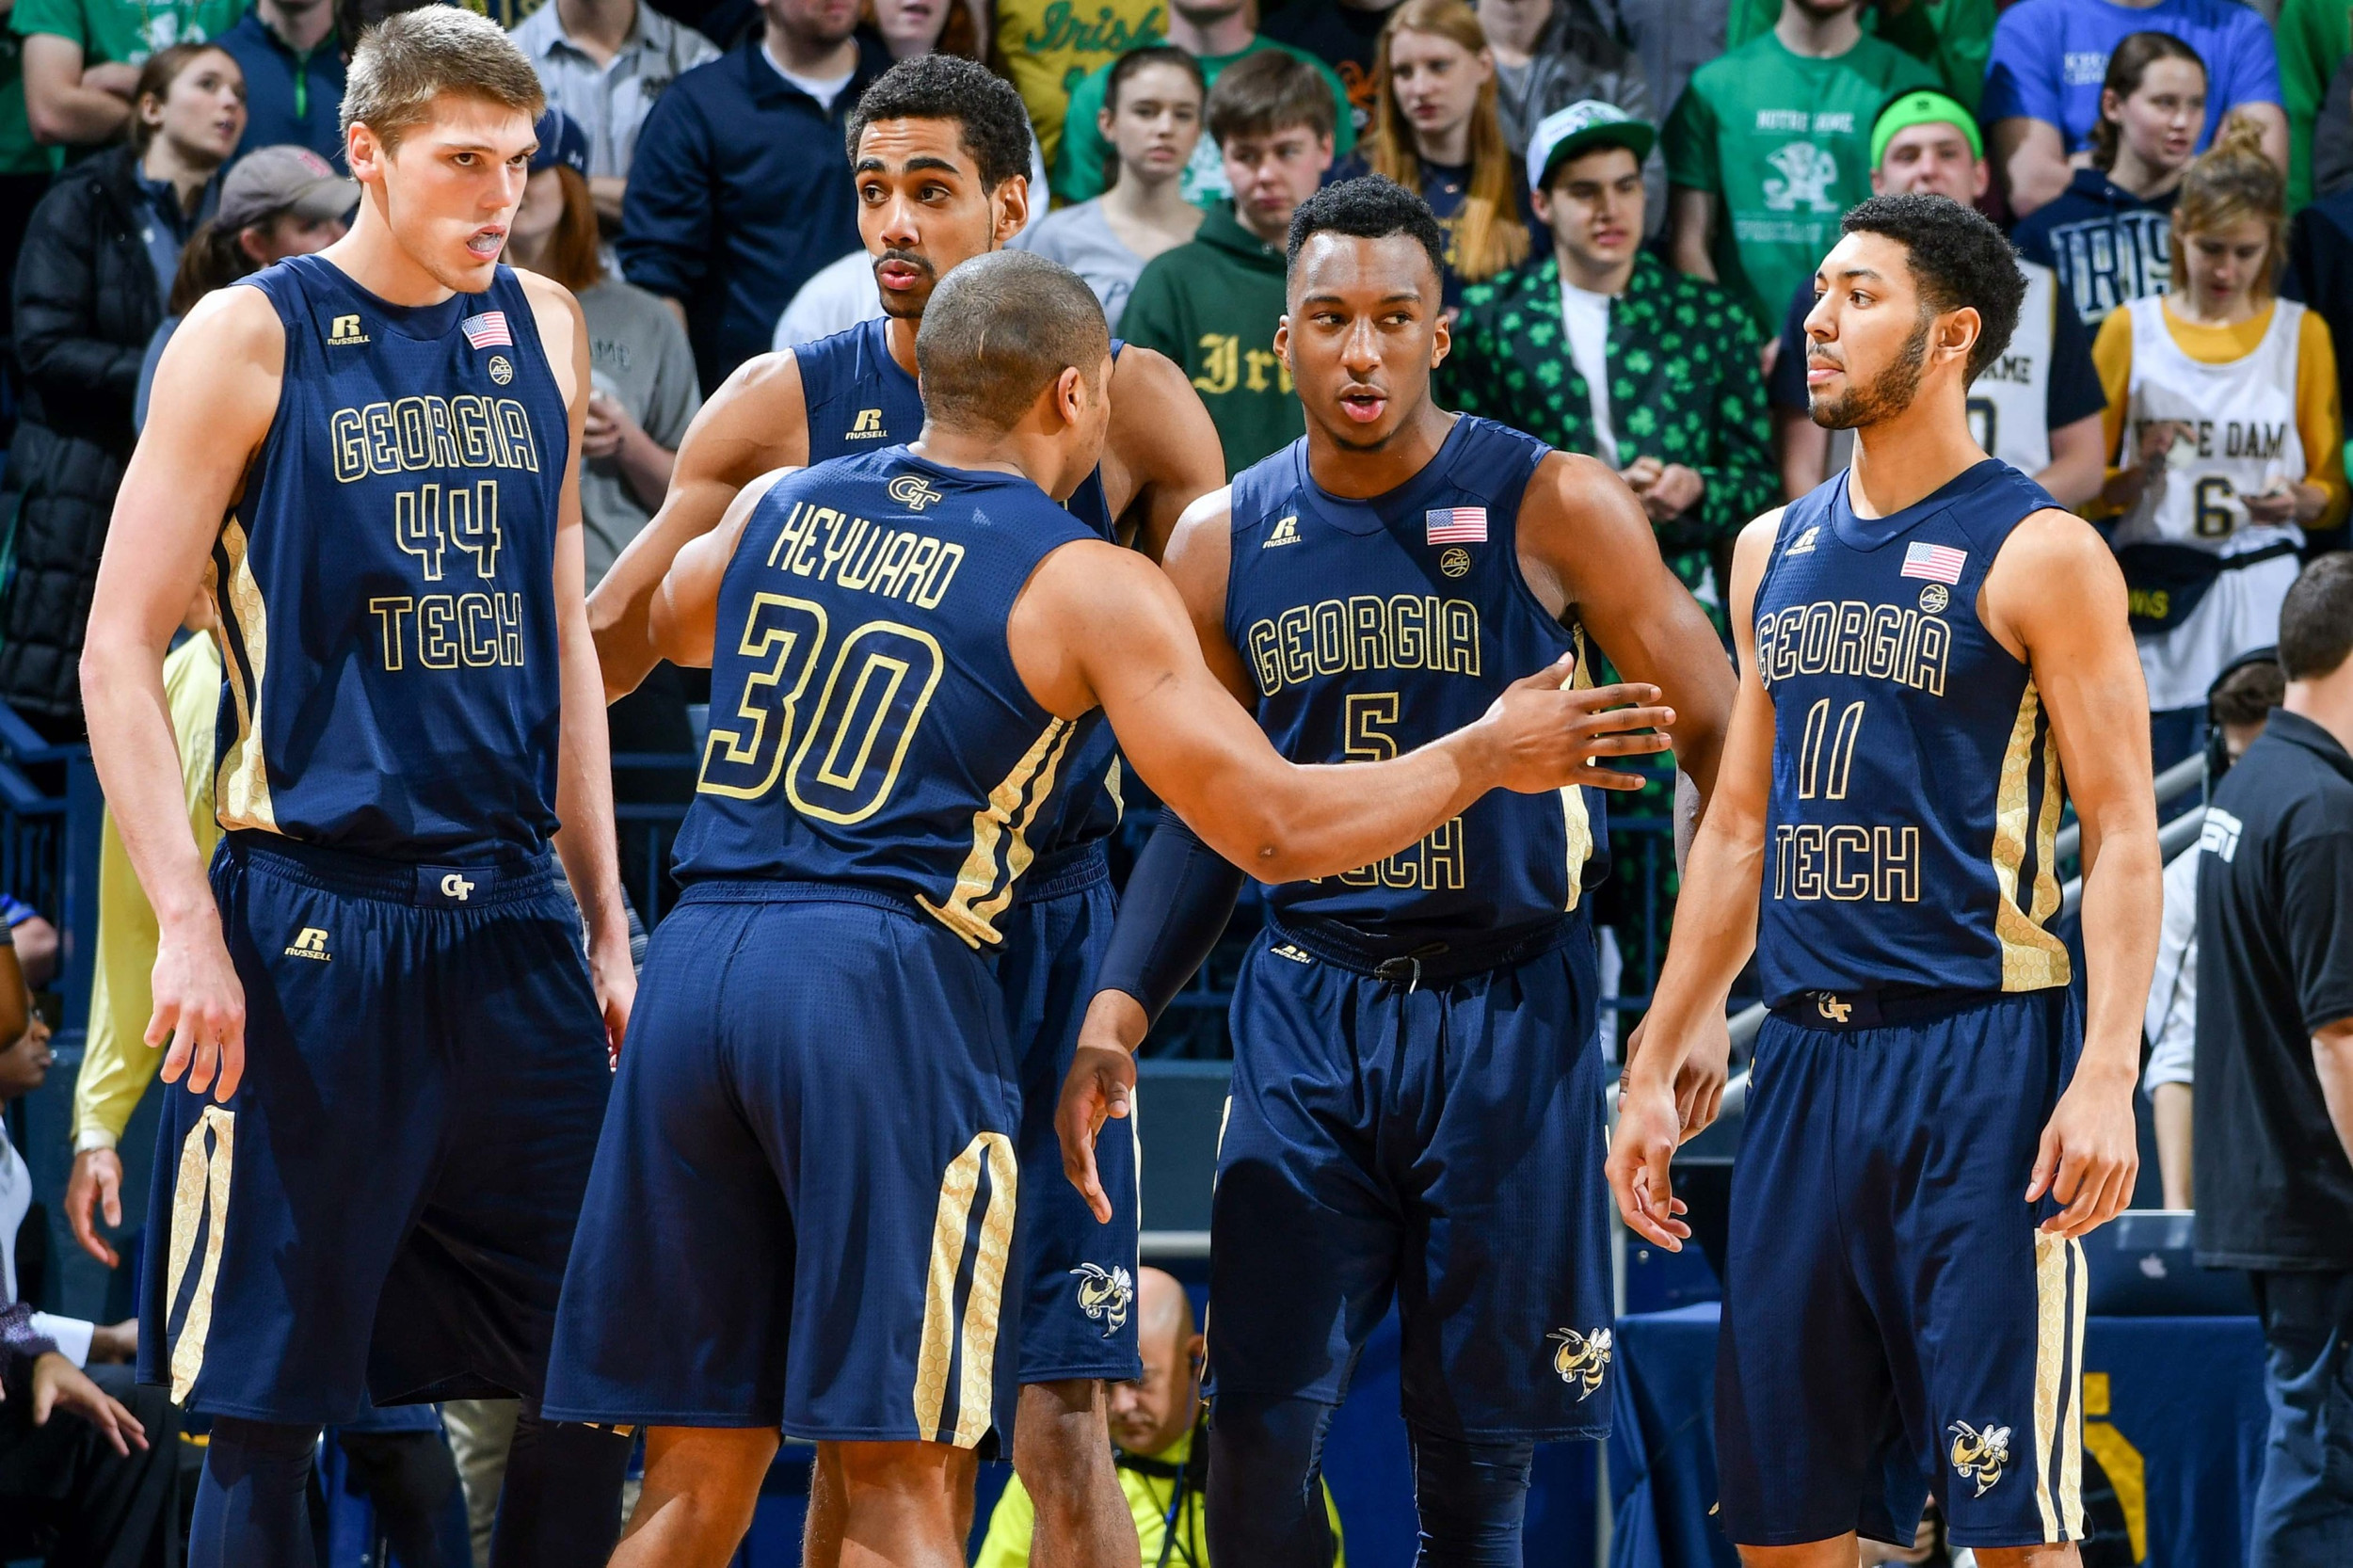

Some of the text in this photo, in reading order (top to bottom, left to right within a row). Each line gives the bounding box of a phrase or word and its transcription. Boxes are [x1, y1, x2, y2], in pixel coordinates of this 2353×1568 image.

[1025, 0, 1160, 53] Irish
[328, 334, 371, 345] RUSSELL
[492, 364, 511, 374] ACC
[331, 394, 540, 484] GEORGIA
[845, 430, 888, 440] RUSSELL
[395, 480, 502, 582] 44
[1262, 535, 1303, 550] RUSSELL
[2194, 476, 2235, 538] 6
[766, 502, 966, 611] HEYWARD
[1445, 556, 1468, 567] ACC
[369, 592, 525, 671] TECH
[1921, 593, 1947, 602] ACC
[1248, 594, 1481, 697] GEORGIA
[1755, 600, 1952, 697] GEORGIA
[696, 591, 945, 825] 30
[1344, 691, 1399, 764] 5
[1798, 697, 1865, 800] 11
[1773, 824, 1920, 903] TECH
[284, 947, 332, 962] RUSSELL
